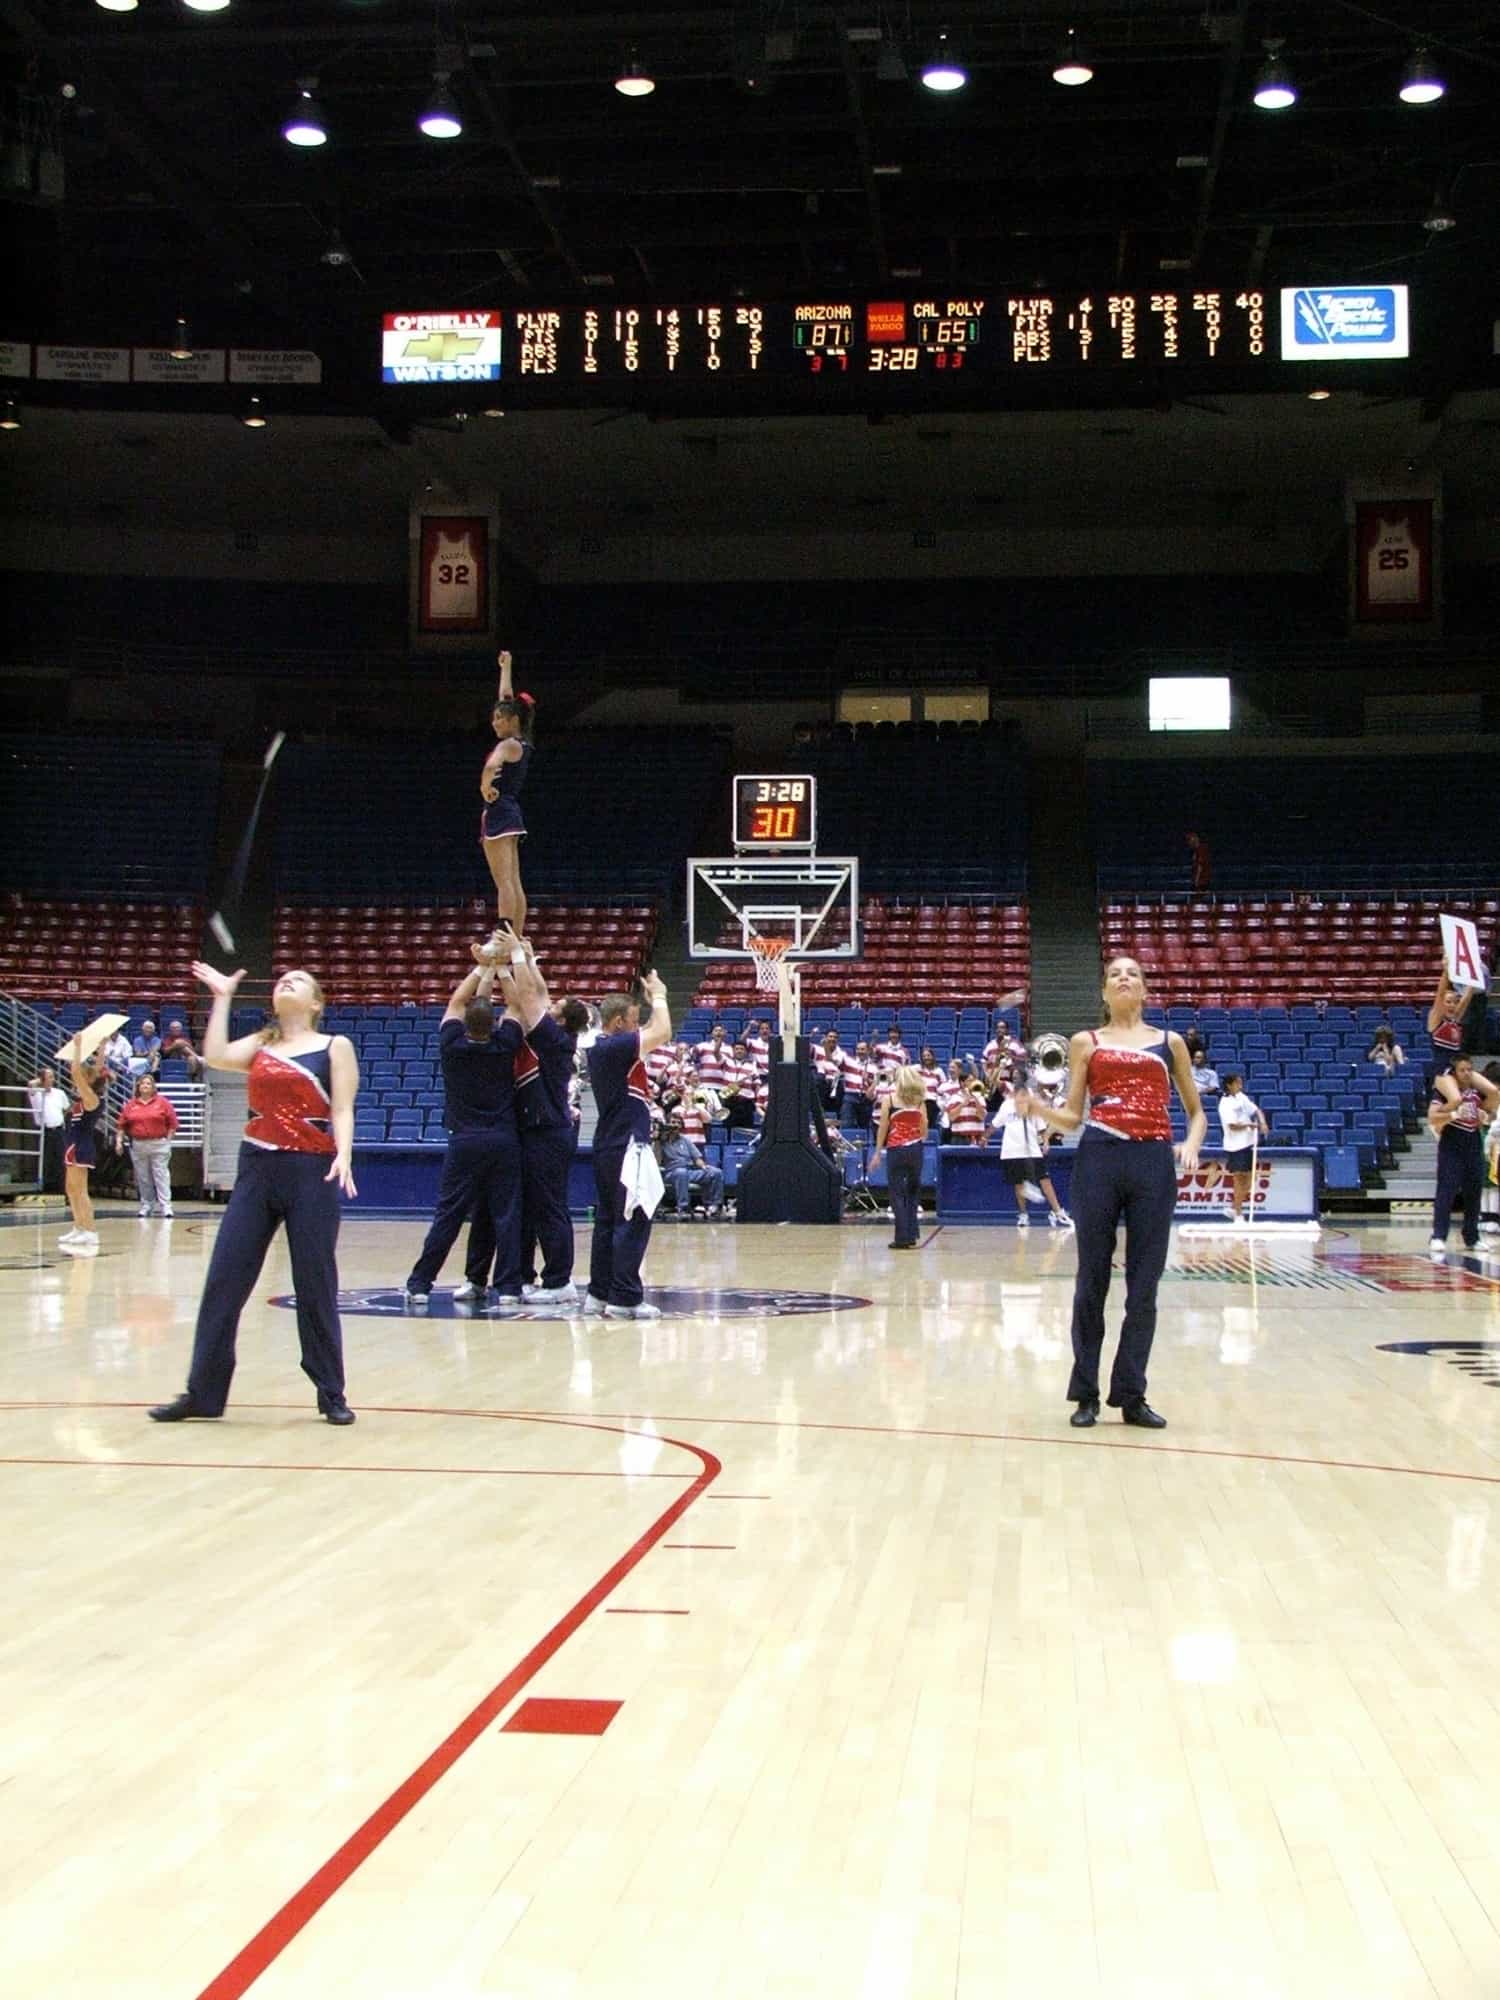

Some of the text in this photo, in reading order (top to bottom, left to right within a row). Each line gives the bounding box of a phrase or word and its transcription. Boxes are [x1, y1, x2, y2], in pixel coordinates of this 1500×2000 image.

[795, 305, 852, 320] ARIZONA
[913, 301, 984, 317] CAL POLY
[1008, 292, 1263, 316] PLYR 4 20 22 25 40
[517, 312, 560, 329] PLYR
[736, 308, 762, 324] 20
[868, 314, 904, 323] WELLS
[869, 323, 903, 331] FARGO
[1016, 315, 1048, 330] PTS
[1206, 309, 1220, 325] 0
[1249, 308, 1263, 324] 0
[585, 328, 598, 342] 0
[708, 324, 721, 339] 0
[749, 323, 762, 339] 7
[812, 324, 841, 346] 87
[937, 321, 966, 342] 65
[1013, 330, 1050, 346] RBS
[1080, 329, 1093, 344] 3
[1206, 324, 1220, 340] 0
[521, 344, 556, 358] RBS
[868, 348, 919, 370] 3:28
[1013, 346, 1050, 362] FLS
[1164, 342, 1178, 357] 2
[1249, 340, 1263, 355] 0
[392, 365, 491, 381] WATSON
[521, 359, 556, 374] FLS
[625, 356, 638, 371] 0
[707, 355, 720, 370] 0
[1378, 549, 1409, 570] 25
[438, 564, 469, 584] 32
[756, 782, 804, 801] 3:28
[752, 808, 795, 837] 30
[1455, 924, 1479, 981] A
[1177, 1192, 1213, 1202] AM
